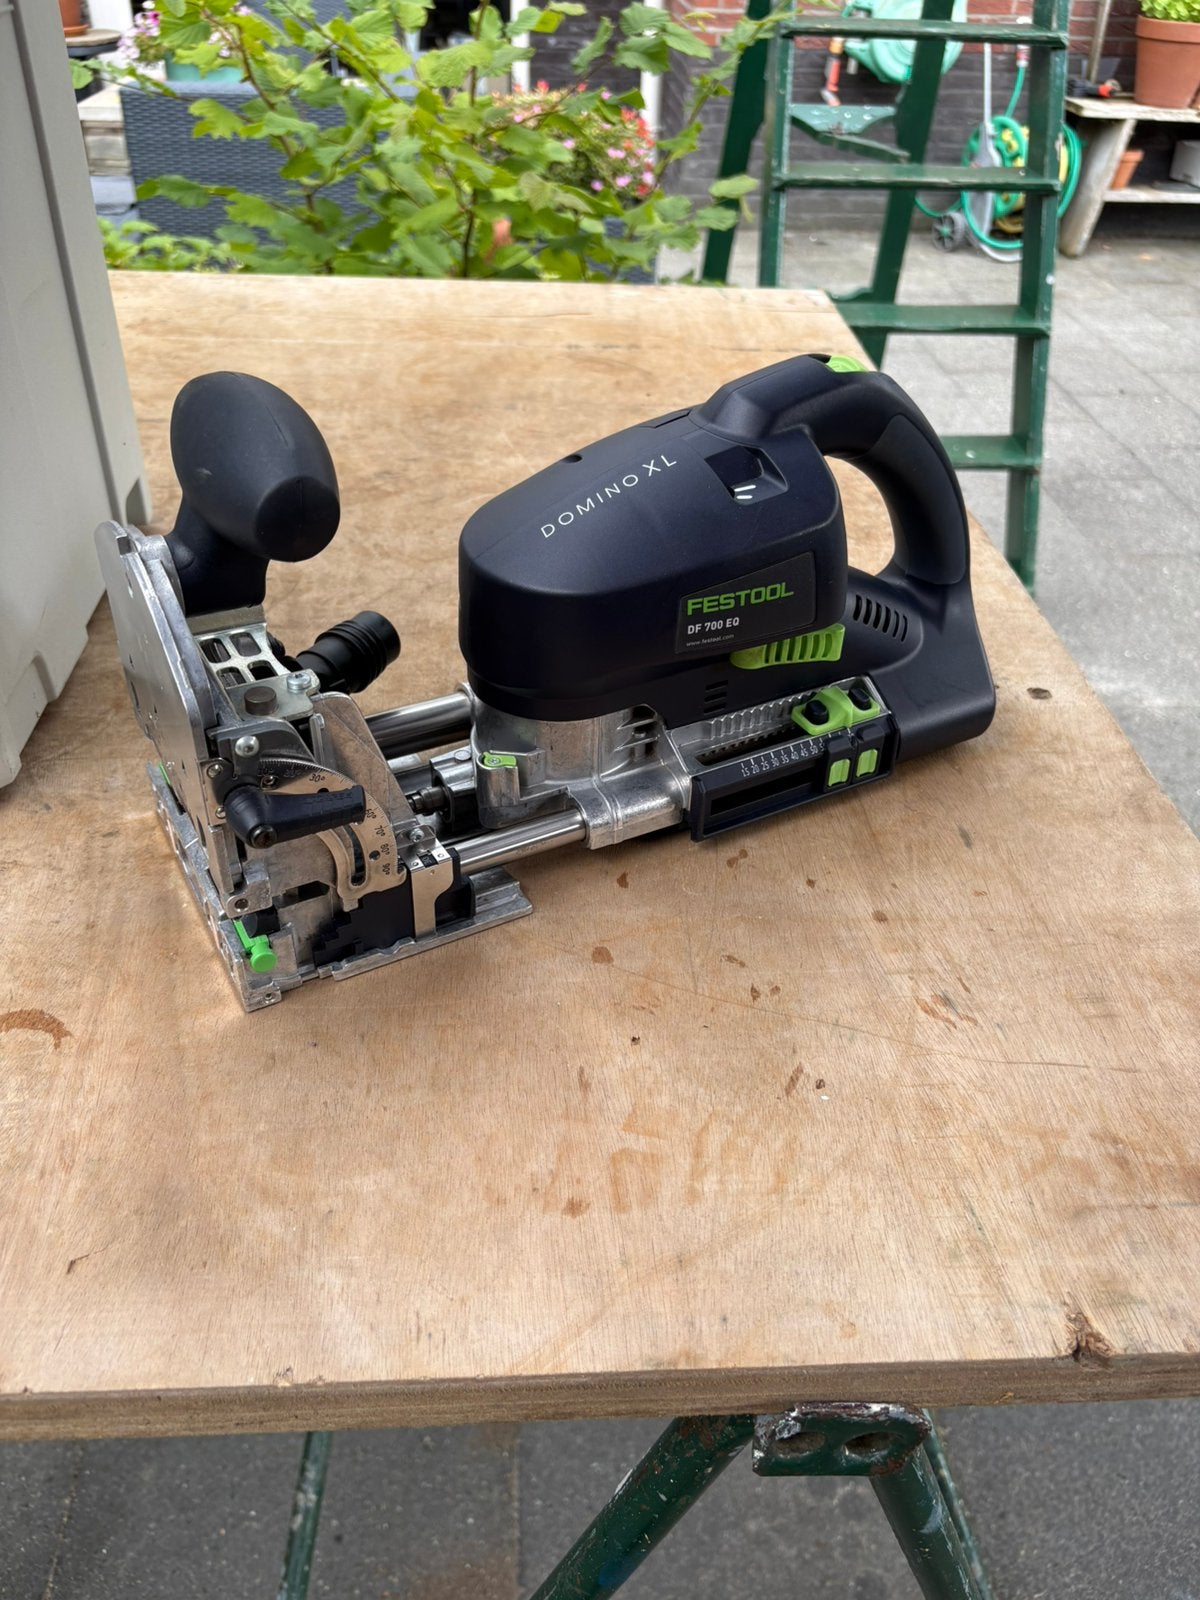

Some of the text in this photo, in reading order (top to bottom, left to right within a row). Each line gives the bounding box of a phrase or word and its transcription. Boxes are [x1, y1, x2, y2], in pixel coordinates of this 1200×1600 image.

[540, 454, 678, 538] DOMINO XL
[687, 581, 795, 616] FESTOOL
[686, 632, 735, 648] www.festool.com
[687, 616, 740, 635] DF 700 EQ
[741, 769, 750, 778] 15
[751, 764, 760, 774] 20
[761, 762, 770, 771] 25
[771, 758, 780, 767] 30
[781, 754, 790, 764] 35
[790, 751, 800, 761] 40
[800, 748, 809, 757] 45
[809, 745, 819, 755] 50
